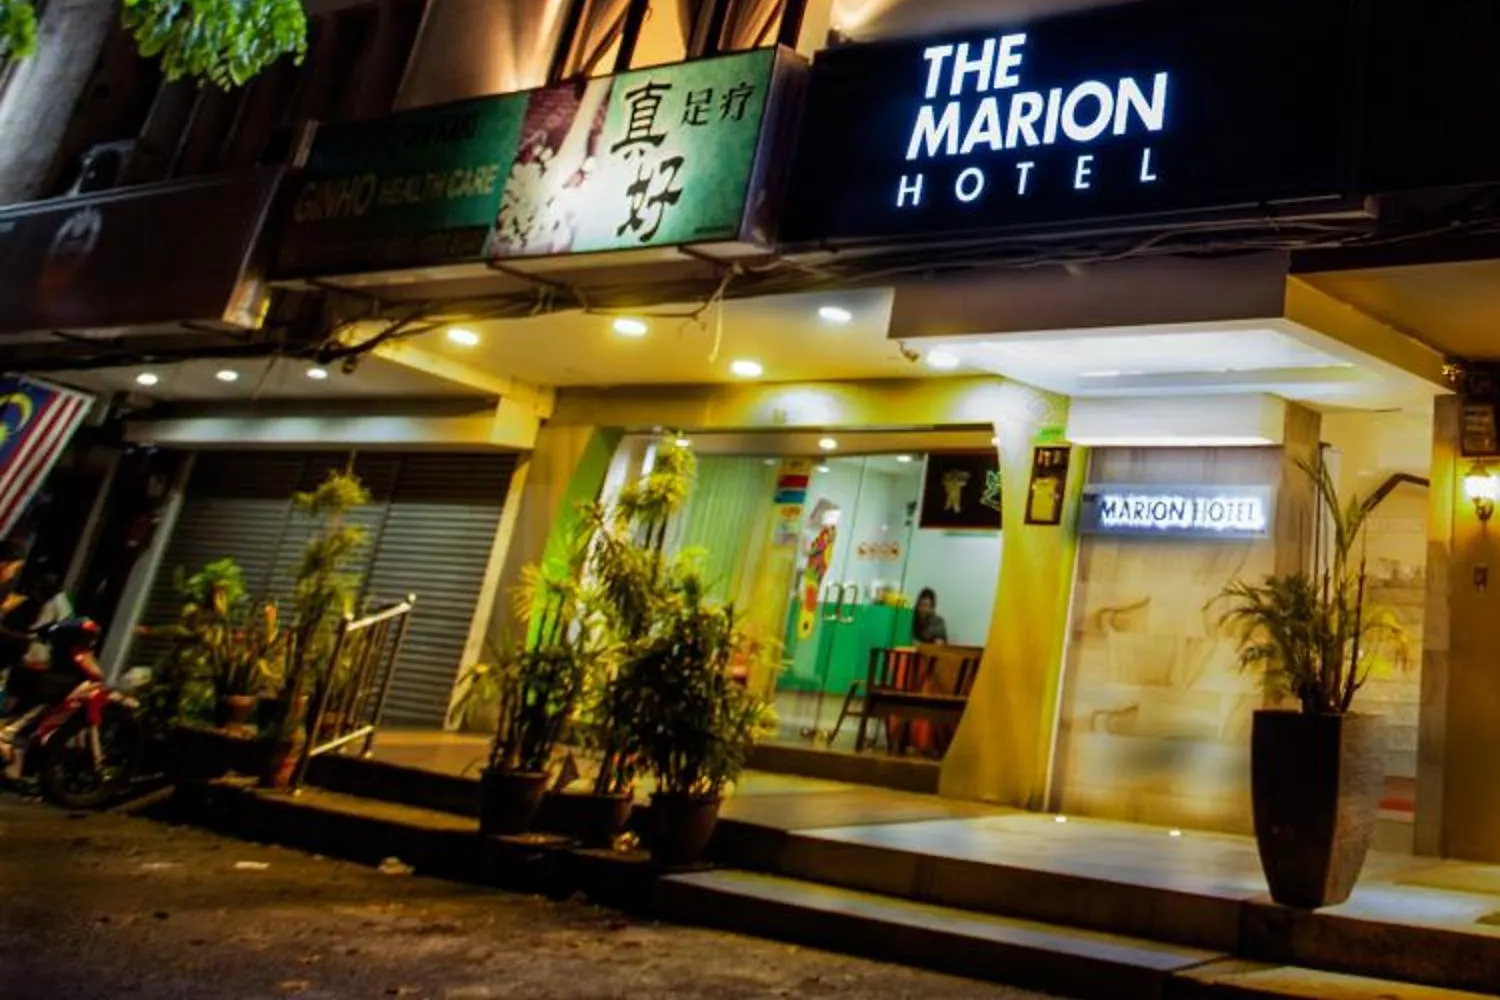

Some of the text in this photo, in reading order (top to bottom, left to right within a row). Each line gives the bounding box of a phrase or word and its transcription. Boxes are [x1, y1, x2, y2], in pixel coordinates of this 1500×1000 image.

[922, 32, 1027, 98] THE
[905, 72, 1168, 161] MARION
[896, 147, 1158, 207] HOTEL
[1099, 499, 1186, 522] MARION
